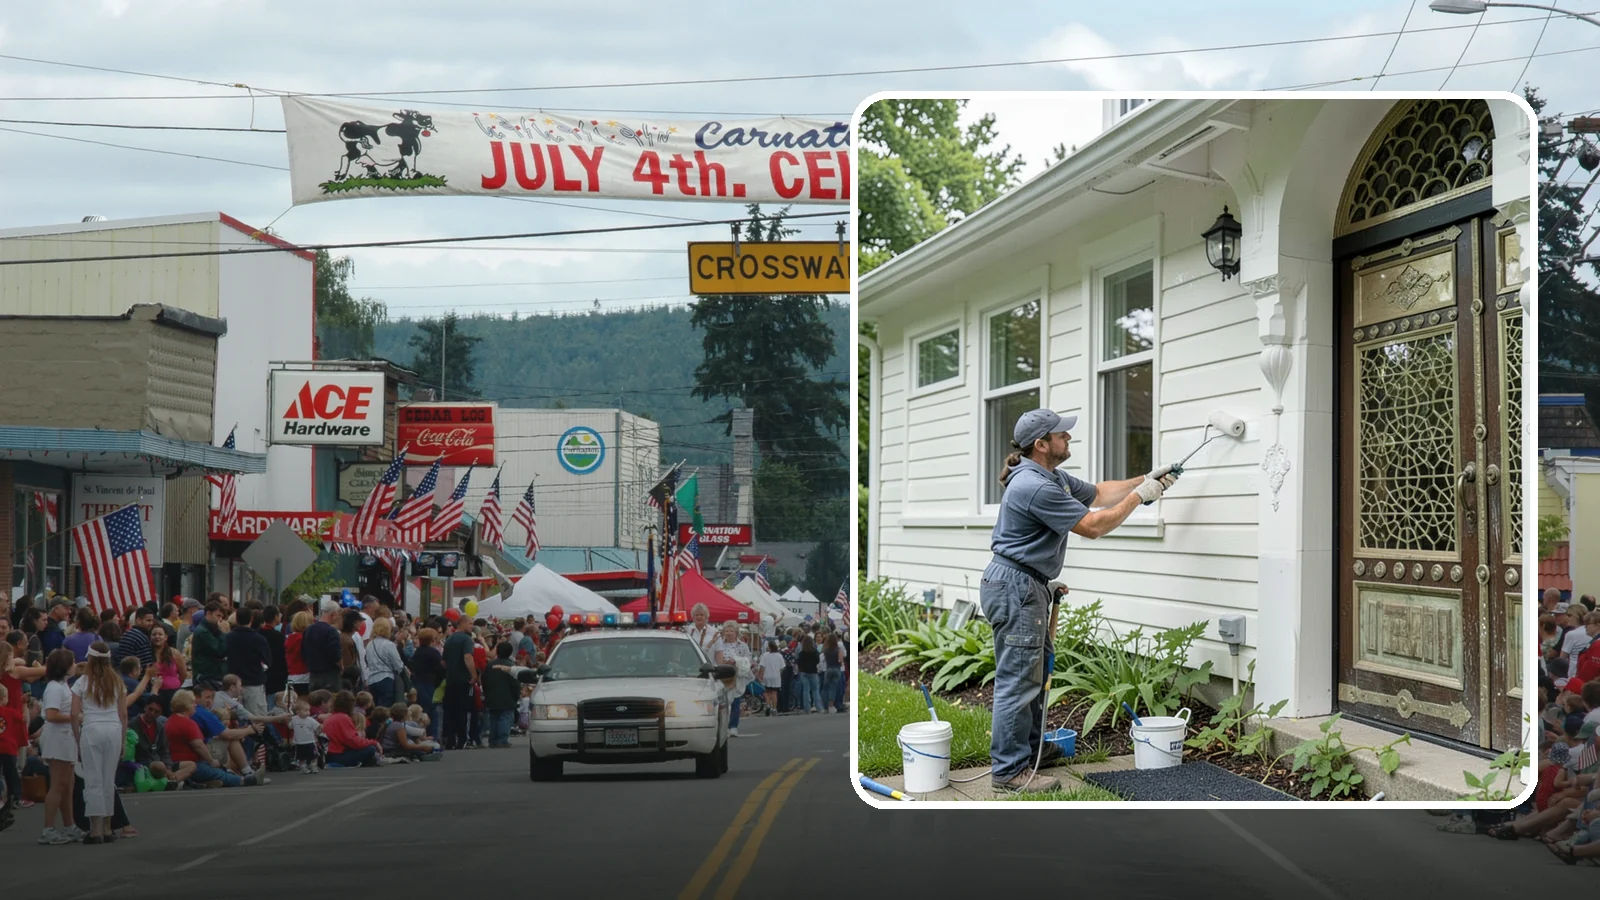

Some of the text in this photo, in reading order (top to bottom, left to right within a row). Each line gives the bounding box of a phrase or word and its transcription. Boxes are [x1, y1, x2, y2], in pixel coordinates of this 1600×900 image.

[481, 141, 605, 192] JULY
[632, 150, 746, 197] 4th.
[697, 254, 850, 280] CROSSWA
[282, 380, 374, 420] ACE
[406, 409, 453, 422] CEDAR
[283, 421, 371, 436] Hardware
[354, 466, 386, 480] Simpl
[83, 484, 155, 495] St. Vincent de Paul
[688, 526, 741, 535] CRNATION
[699, 535, 730, 543] GLASS
